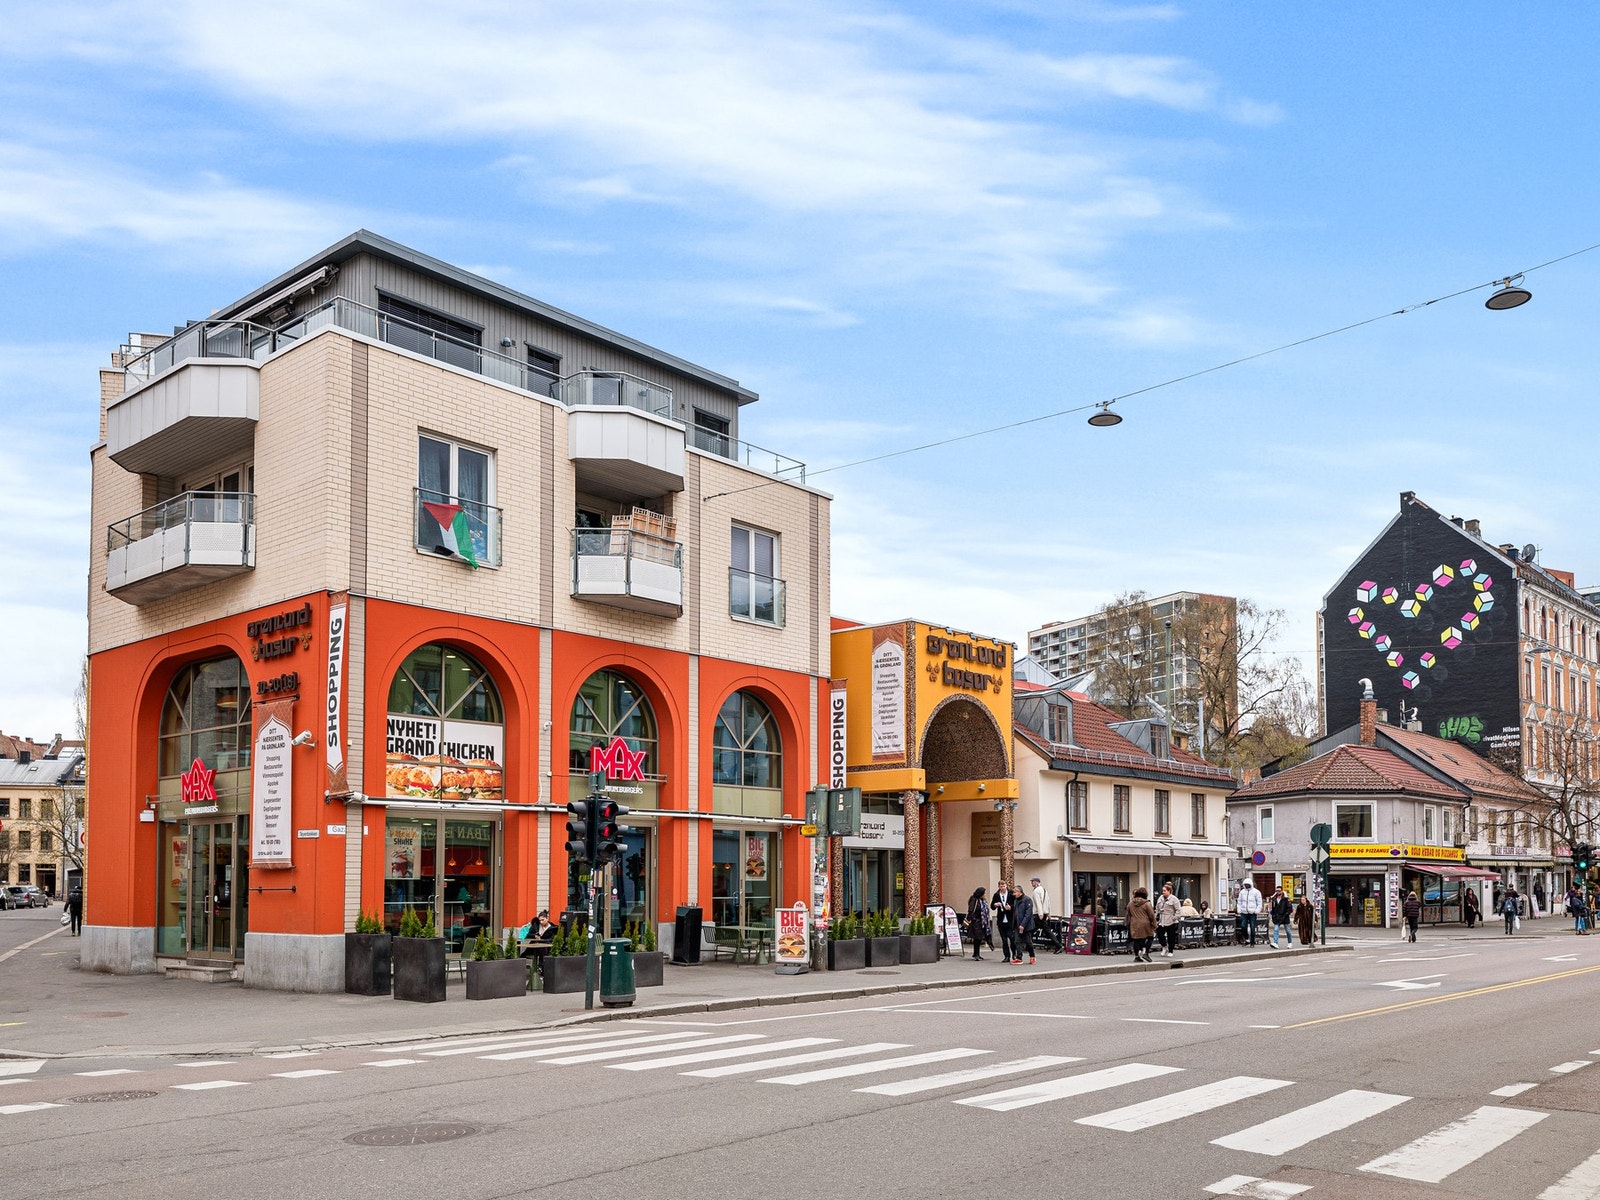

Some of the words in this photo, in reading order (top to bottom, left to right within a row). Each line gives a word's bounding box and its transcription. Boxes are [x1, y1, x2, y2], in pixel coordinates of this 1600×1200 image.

[926, 635, 1006, 668] Grønland
[328, 617, 343, 748] SHOPPING
[942, 660, 993, 691] basar
[387, 719, 436, 740] NYHET!
[833, 699, 844, 790] SHOPPING
[387, 737, 434, 756] GRAND
[590, 736, 646, 782] MAX
[181, 757, 218, 802] MAX
[748, 837, 764, 850] BIG
[781, 911, 804, 926] BIG
